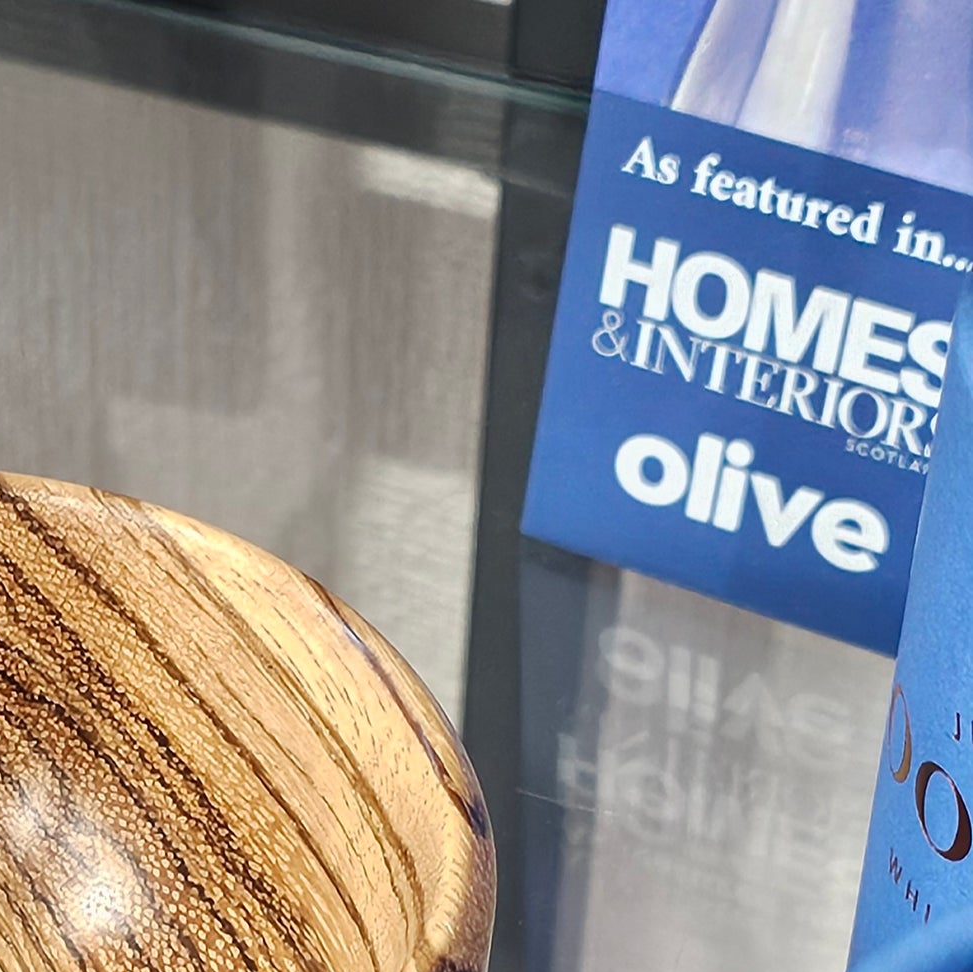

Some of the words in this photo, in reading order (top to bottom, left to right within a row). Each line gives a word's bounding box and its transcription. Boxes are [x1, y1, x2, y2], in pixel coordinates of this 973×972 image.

[621, 136, 680, 185] As
[690, 154, 884, 245] featured
[591, 309, 941, 458] &INTERIOR
[599, 224, 953, 409] HOMES
[614, 433, 889, 574] olive
